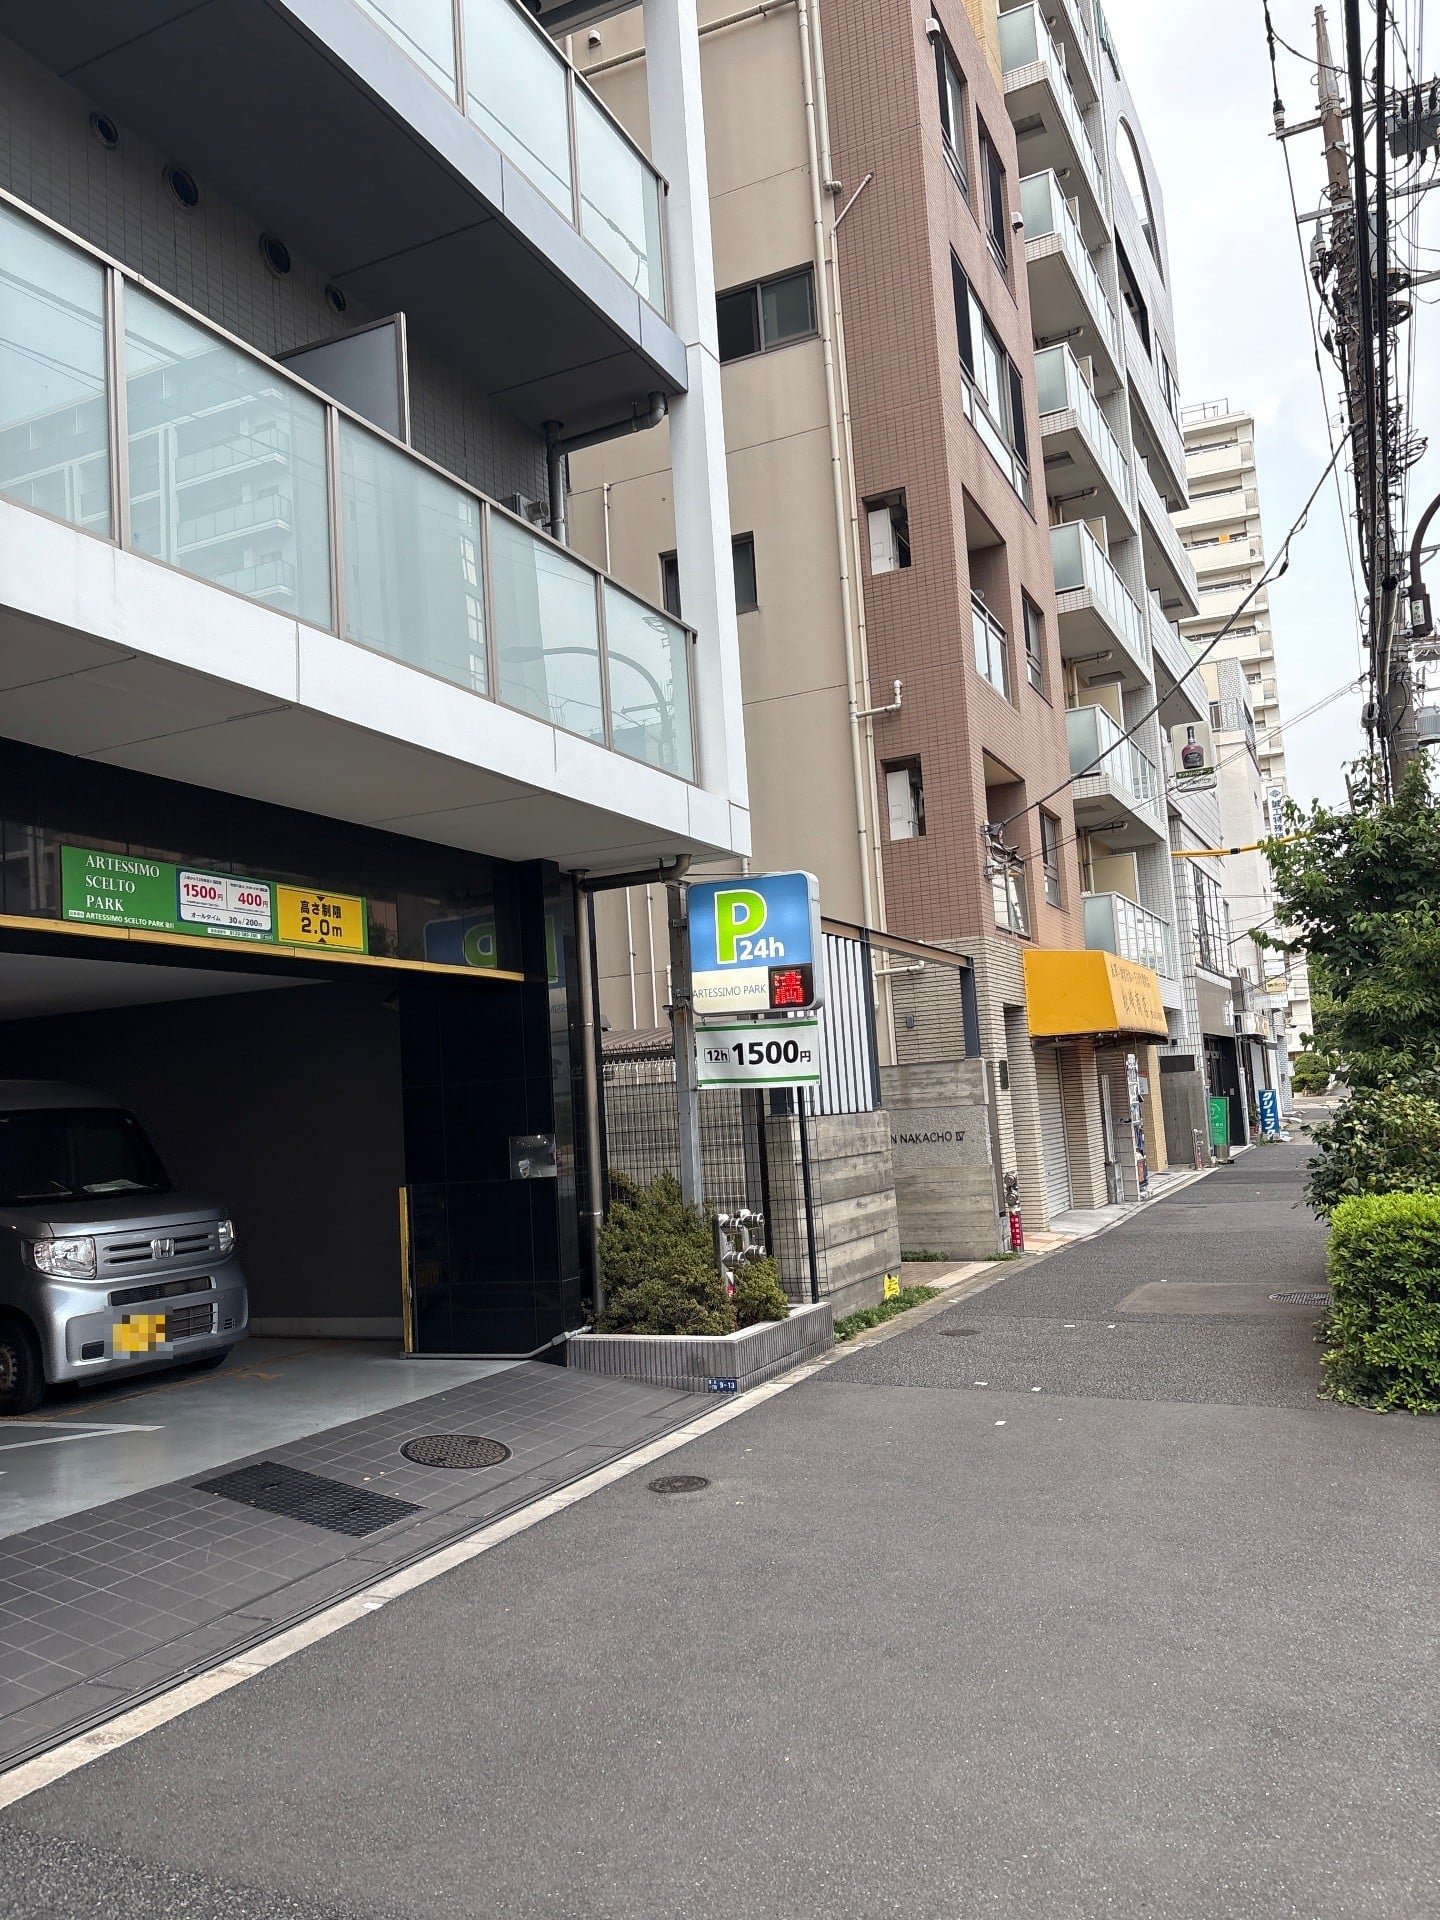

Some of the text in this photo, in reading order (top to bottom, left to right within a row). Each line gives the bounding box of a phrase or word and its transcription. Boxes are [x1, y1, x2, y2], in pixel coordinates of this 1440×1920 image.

[85, 855, 160, 878] ARTESSIMO
[85, 875, 136, 893] SCELTO
[183, 883, 224, 902] 1500円
[86, 894, 124, 911] PARK
[238, 892, 269, 908] 400円
[300, 899, 342, 919] 高さ制限
[86, 912, 122, 922] ARTESSIMO
[124, 916, 147, 926] SCELTO
[191, 911, 221, 921] オールタイム
[301, 916, 342, 938] 2.0m
[714, 889, 768, 965] P
[740, 936, 785, 961] 24h
[693, 984, 767, 999] ARTESSIMO PARK
[706, 1040, 811, 1065] 12h 1500円
[1262, 1092, 1276, 1139] クリーニング
[900, 1131, 952, 1144] NAKACHO
